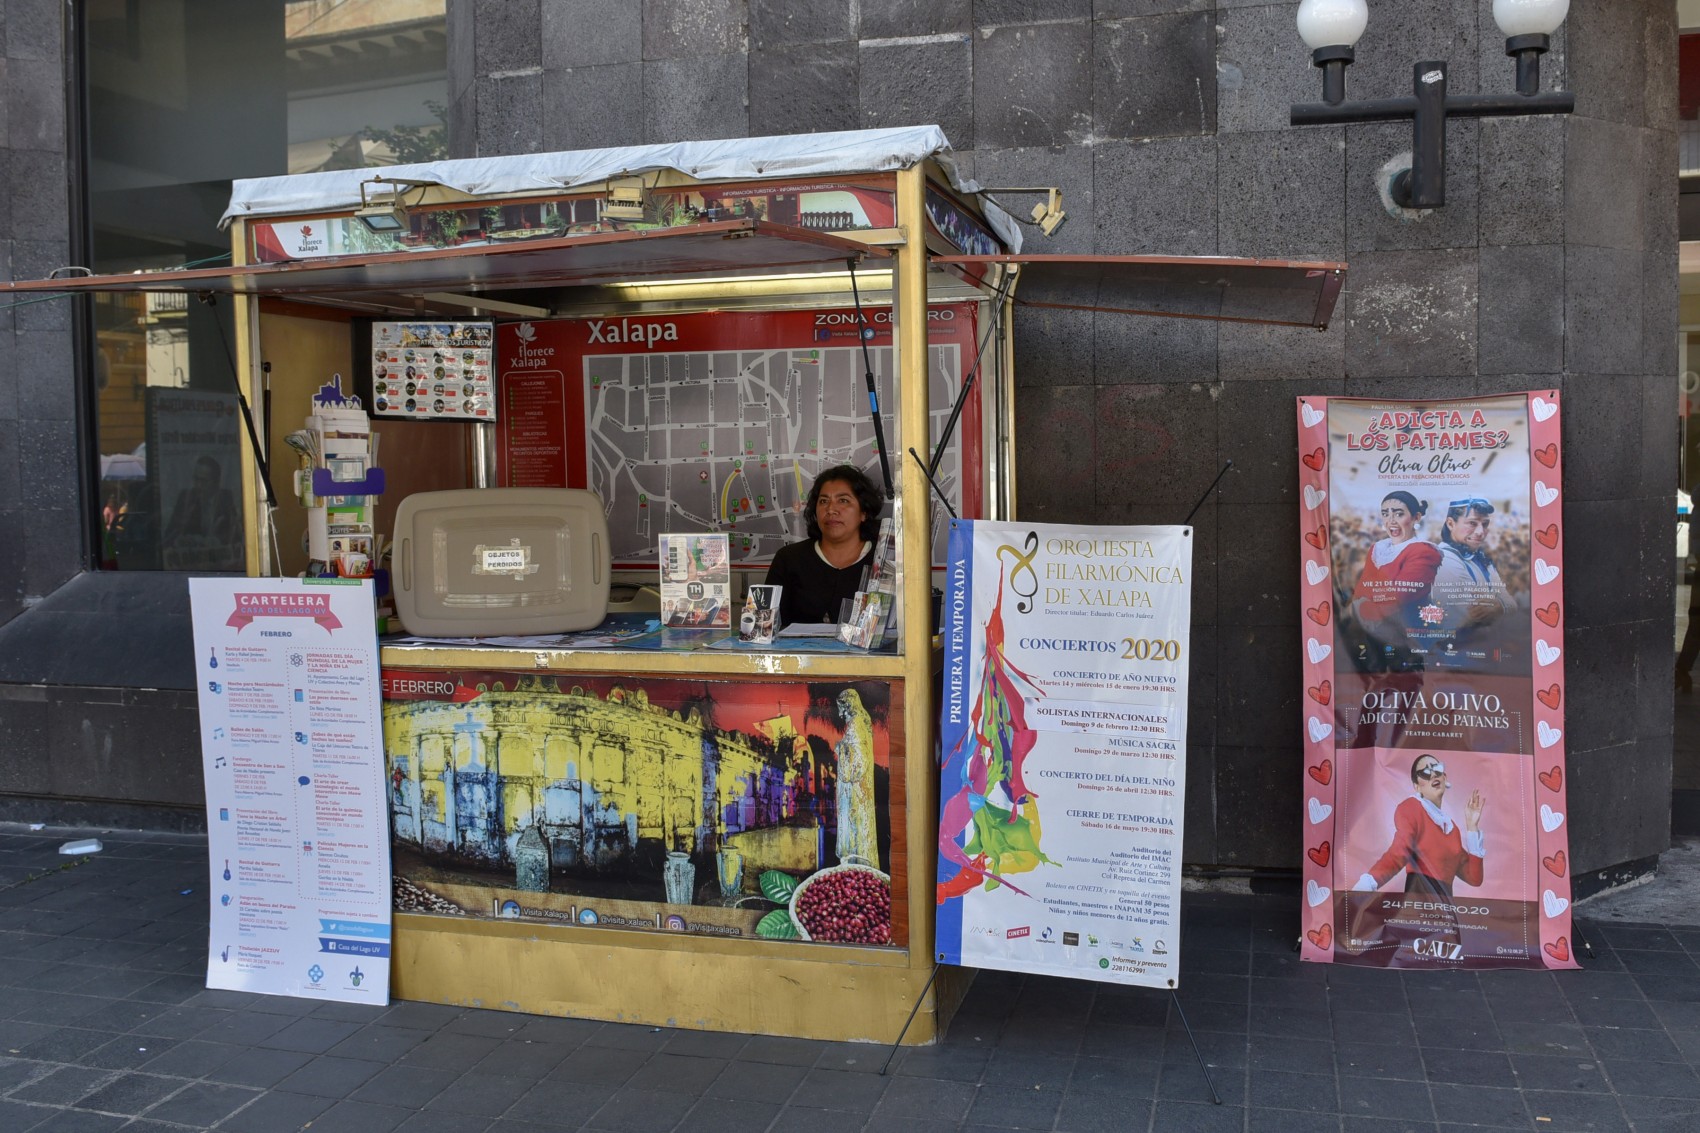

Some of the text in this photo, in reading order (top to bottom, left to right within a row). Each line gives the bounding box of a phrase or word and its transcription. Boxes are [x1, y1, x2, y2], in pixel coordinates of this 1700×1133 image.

[815, 310, 954, 325] ZONA CERO
[587, 318, 678, 348] Xalapa
[519, 346, 554, 358] florece
[511, 357, 547, 369] Xalapa
[1367, 409, 1488, 434] ¿ADICTA A
[1346, 430, 1509, 452] LOS PATANES?
[1378, 453, 1422, 474] Oliva
[1046, 538, 1154, 558] ORQUESTA
[1046, 561, 1184, 584] FILARMÓNICA
[689, 585, 702, 594] TH
[1395, 580, 1424, 588] FEBRERO
[240, 596, 325, 606] CARTELERA
[1045, 587, 1152, 608] DE XALAPA
[1135, 612, 1154, 620] Juárez
[950, 559, 966, 724] PRIMERA TEMPORADA
[1020, 637, 1180, 662] CONCIERTOS 2020
[1053, 670, 1176, 684] CONCIERTO DE AÑO NUEVO
[393, 679, 454, 694] FEBRERO
[1075, 681, 1104, 689] miércoles
[1160, 685, 1177, 693] HRS.
[1362, 691, 1505, 715] OLIVA OLIVO,
[1036, 708, 1168, 724] SOLISTAS INTERNACIONALES
[1358, 712, 1509, 729] ADICTA A LOS PATANES
[1061, 719, 1090, 728] Domingo
[1105, 722, 1128, 731] febrero
[1130, 724, 1148, 732] 12:30
[1149, 726, 1167, 734] HRS.
[1108, 737, 1176, 750] MÚSICA SACRA
[1039, 770, 1175, 787] CONCIERTO DEL DÍA DEL NIÑO
[1077, 783, 1105, 791] Domingo
[1124, 786, 1138, 794] abril
[1158, 789, 1175, 797] HRS.
[1066, 809, 1174, 826] CIERRE DE TEMPORADA
[1110, 851, 1140, 860] Auditorio
[1151, 855, 1171, 863] IMAC
[1131, 846, 1161, 854] Auditorio
[1043, 897, 1080, 908] Estudiantes,
[1081, 902, 1108, 910] maestros
[1114, 905, 1143, 914] INAPAM
[1382, 900, 1490, 915] 24.FEBRERO.20
[523, 908, 569, 919] Visita Xalapa
[1008, 928, 1028, 937] CINETIX
[359, 946, 371, 954] Lago
[1412, 937, 1463, 960] CAUZ
[1112, 956, 1167, 969] Informes y preventa
[1112, 965, 1146, 974] 2281162991
